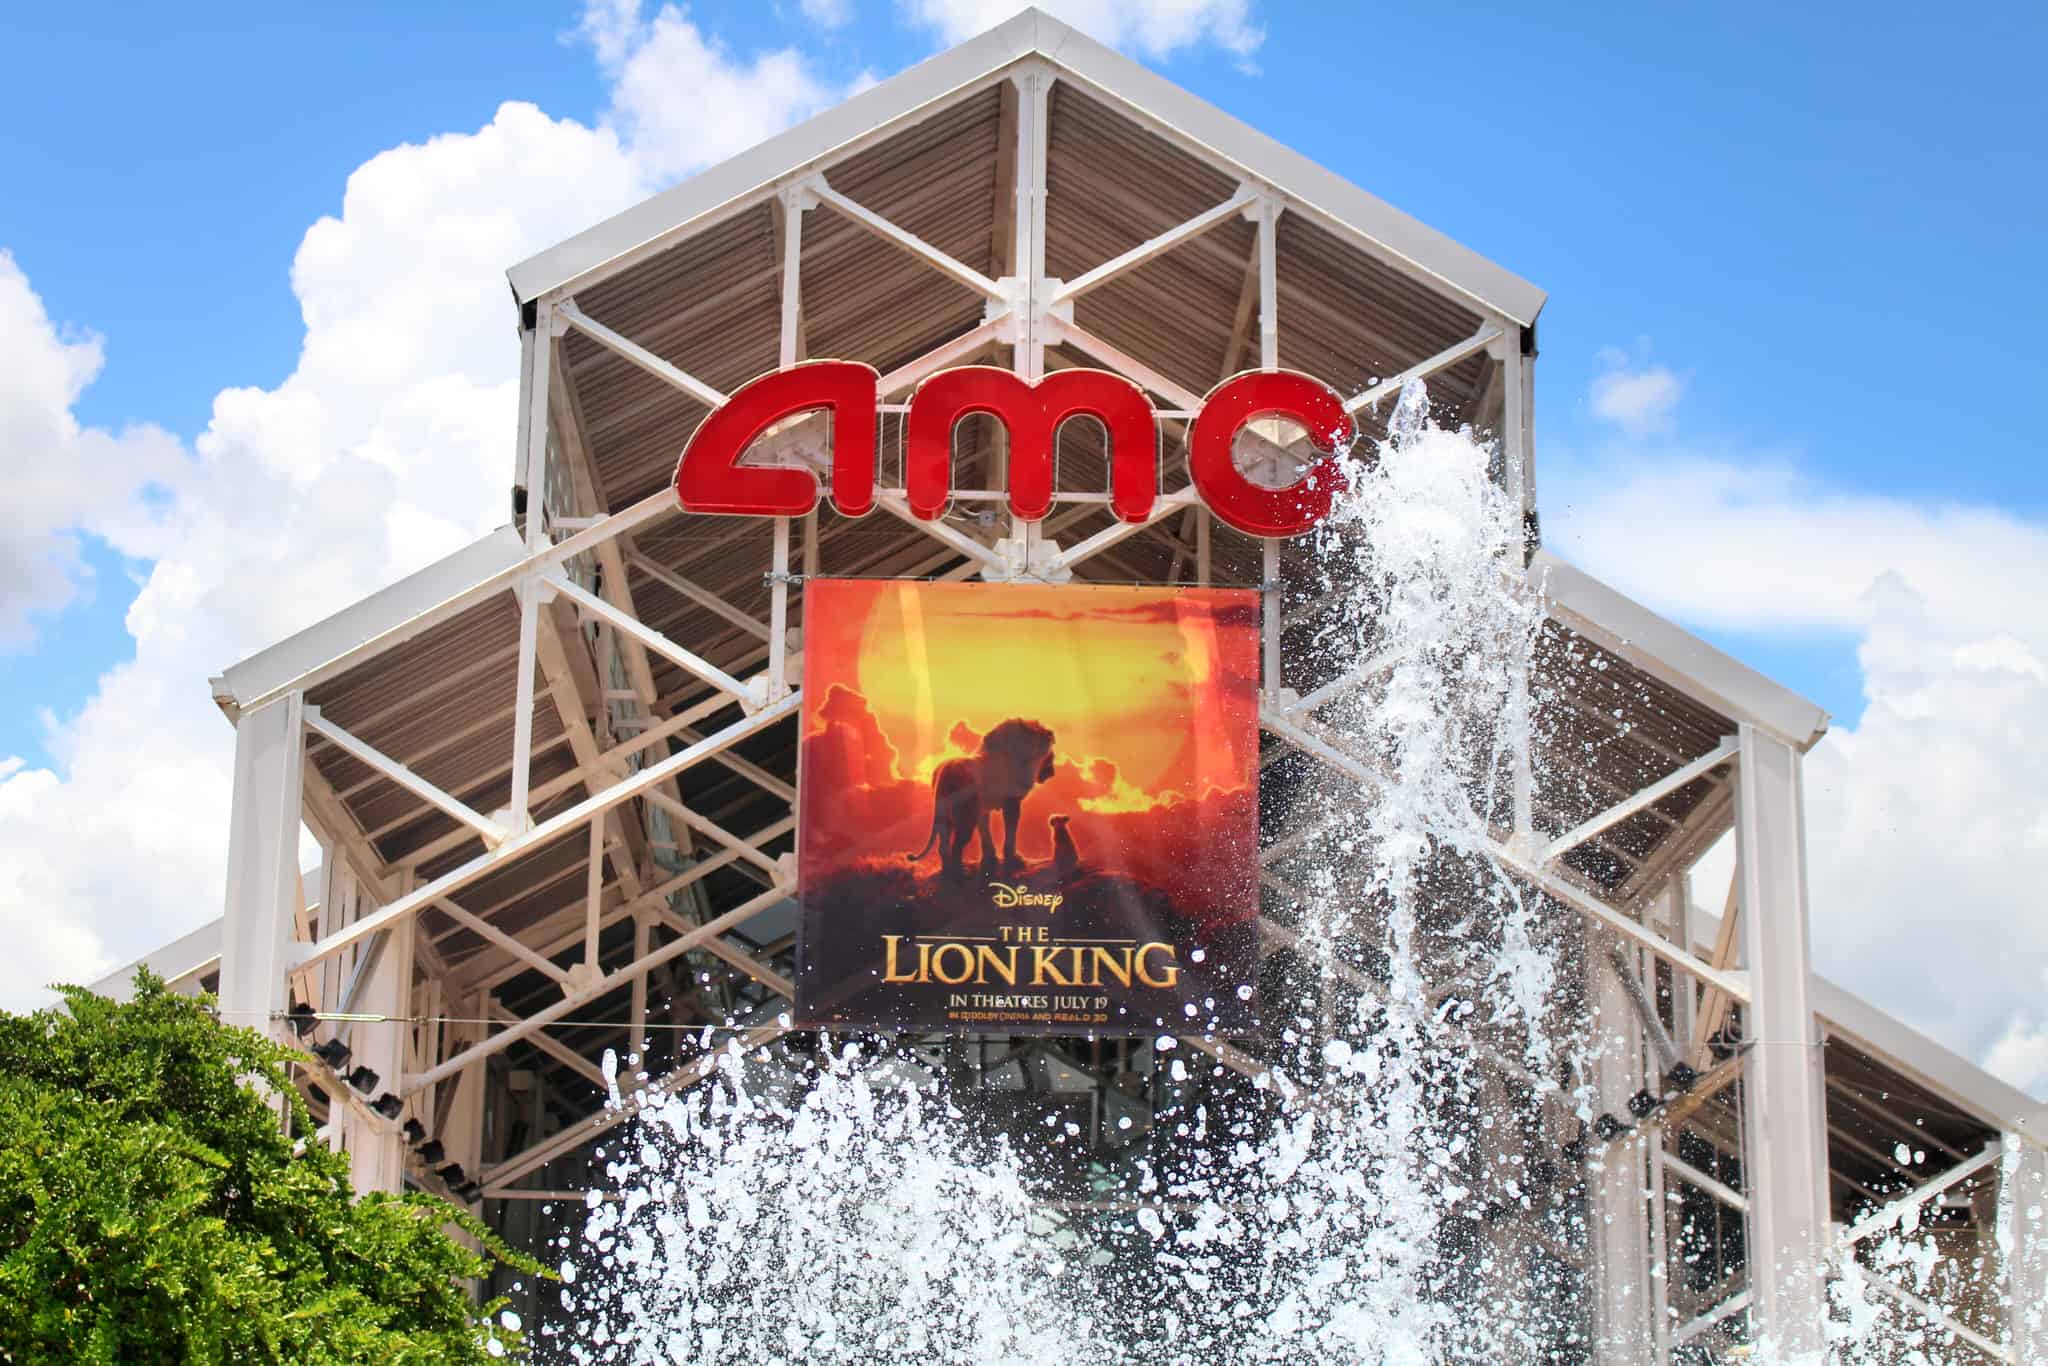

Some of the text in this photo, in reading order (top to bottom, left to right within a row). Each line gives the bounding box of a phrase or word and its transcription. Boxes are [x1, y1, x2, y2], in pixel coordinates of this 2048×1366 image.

[674, 359, 1356, 538] amc
[999, 926, 1049, 943] THE
[881, 935, 1182, 988] LION KING
[950, 994, 1108, 1010] IN THEATRES JULY 19
